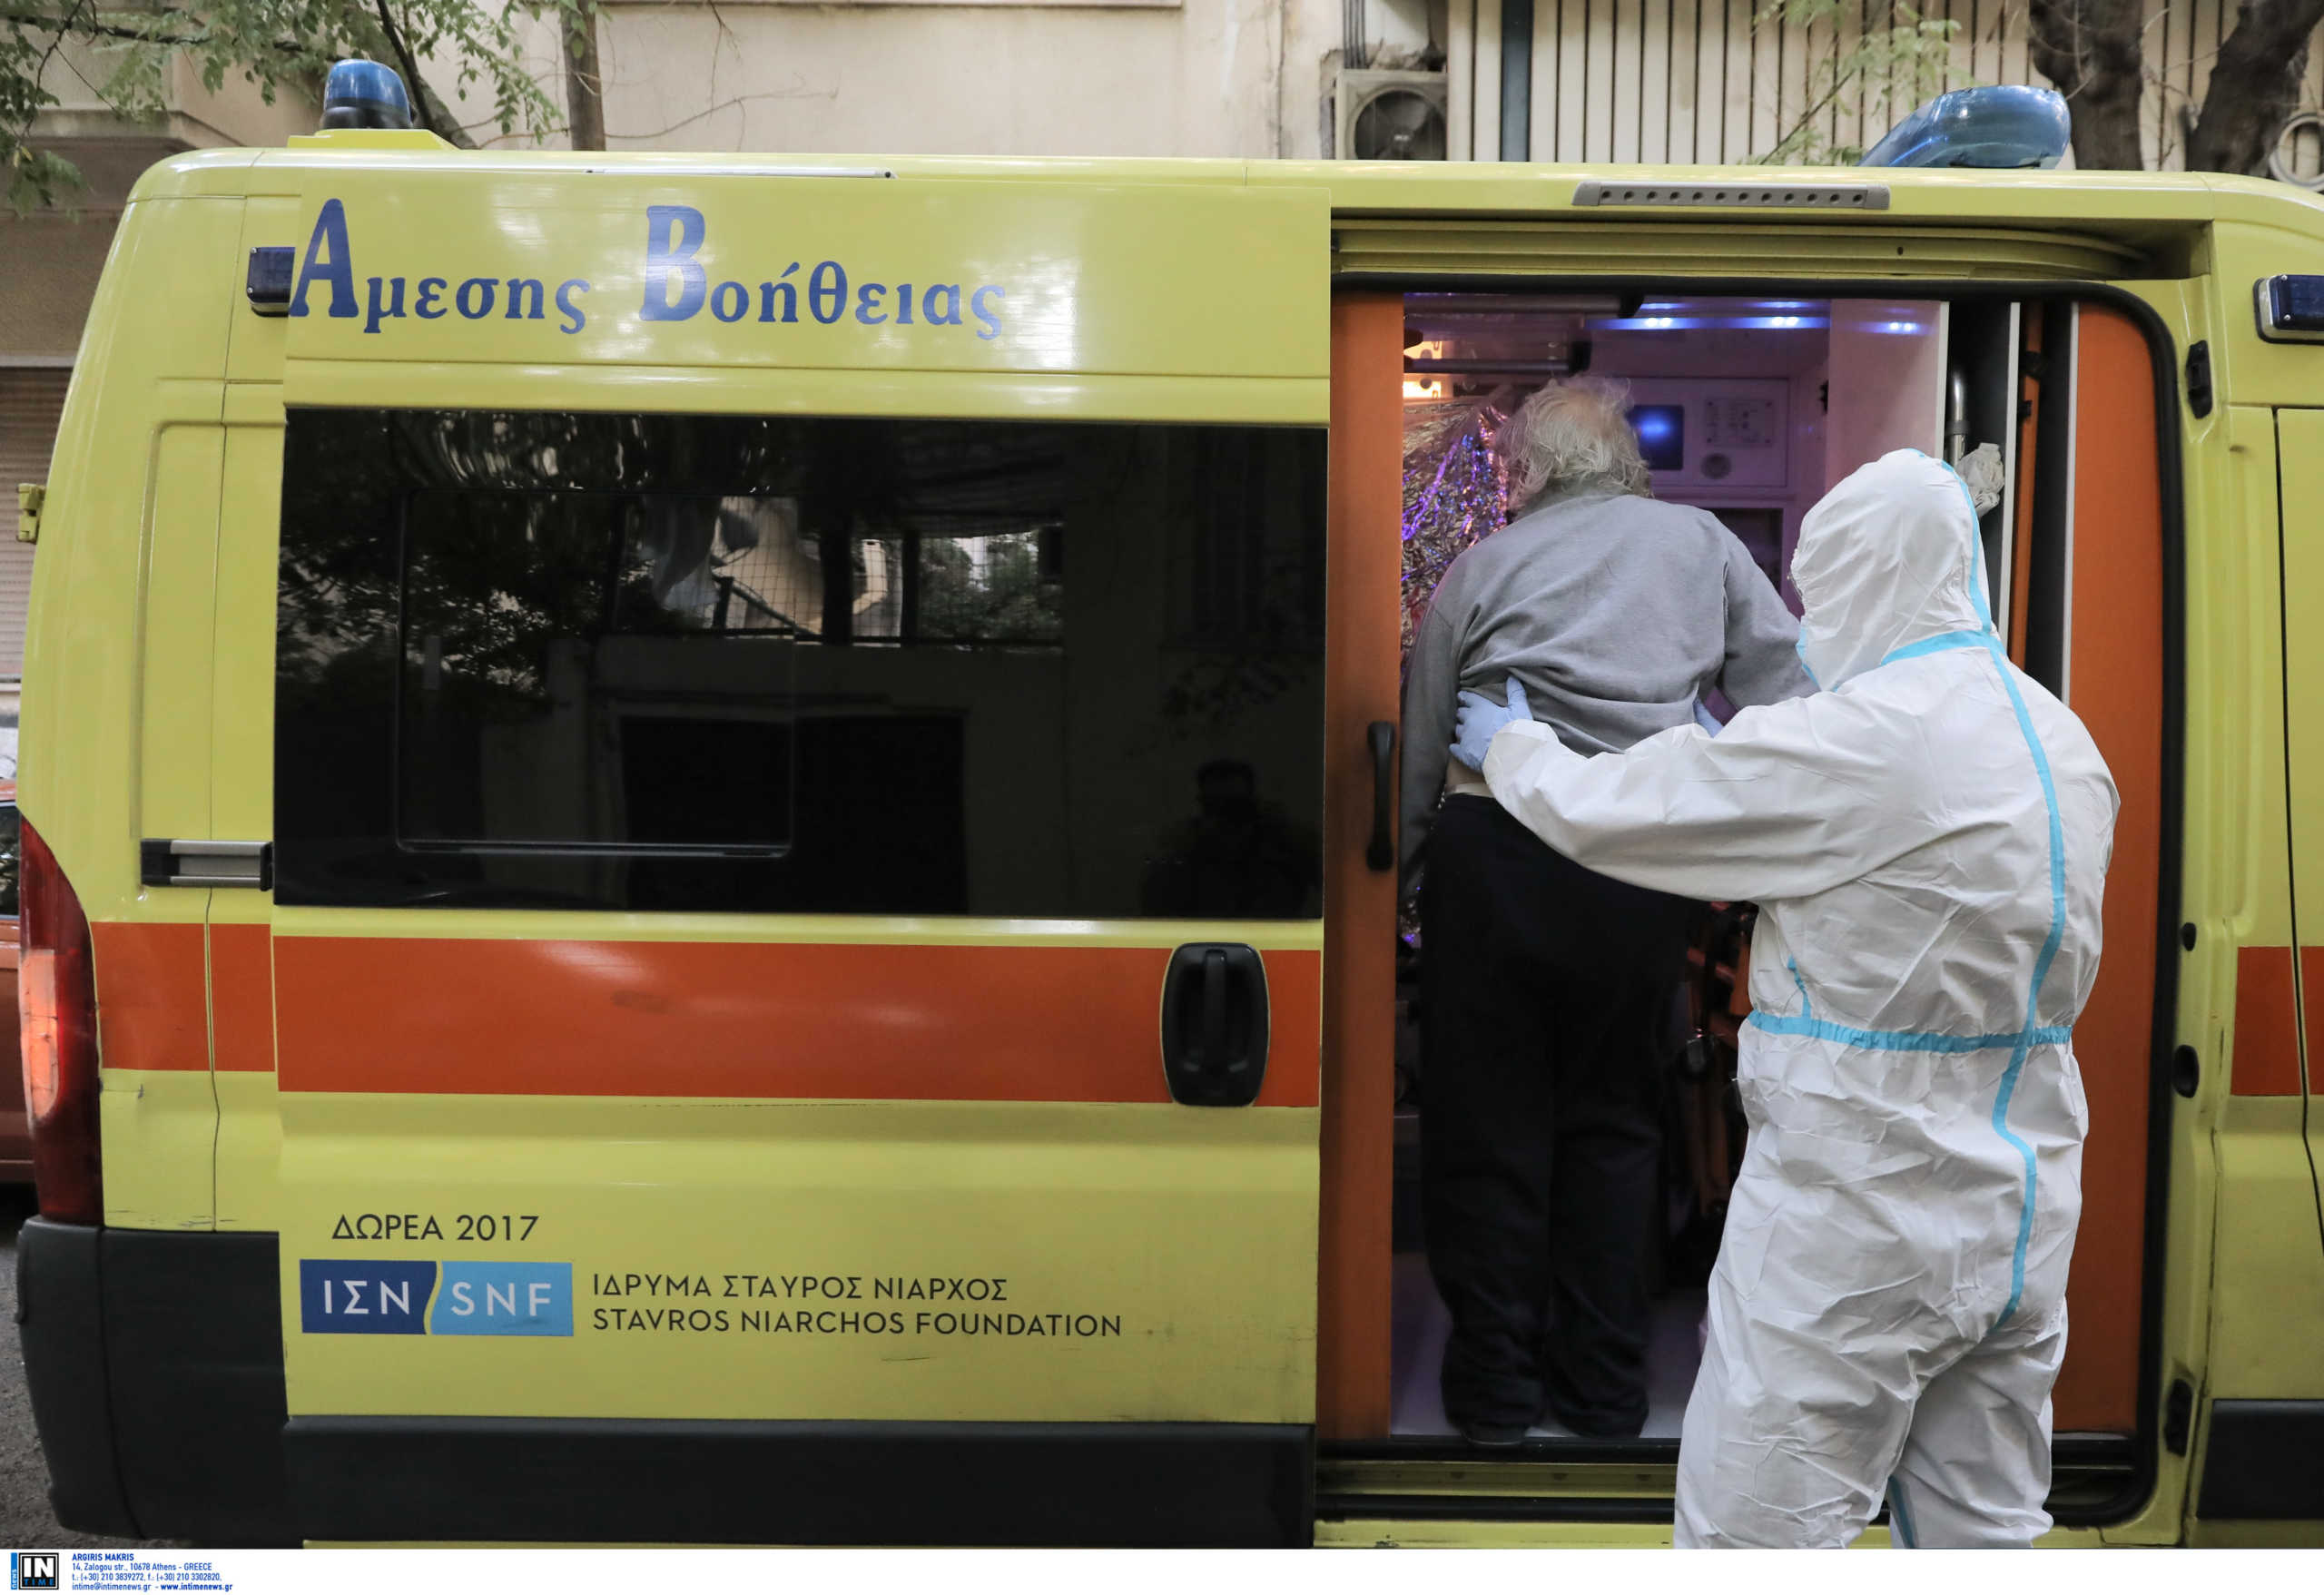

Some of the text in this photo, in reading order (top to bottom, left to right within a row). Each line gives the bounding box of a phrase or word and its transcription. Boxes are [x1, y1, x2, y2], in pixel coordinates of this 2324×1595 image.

[289, 198, 1007, 340] Αμεσης Βοήθειας
[331, 1214, 539, 1242] ΔΩΡΕΑ 2017
[323, 1279, 410, 1315] ΙΣΝ
[450, 1281, 552, 1316] SNF
[593, 1273, 1008, 1302] ΙΔΡΥΜΑ ΣΤΑΥΡΟΣ ΝΙΑΡΧΟΣ
[593, 1308, 1122, 1337] STAVROS NIARCHOS FOUNDATION
